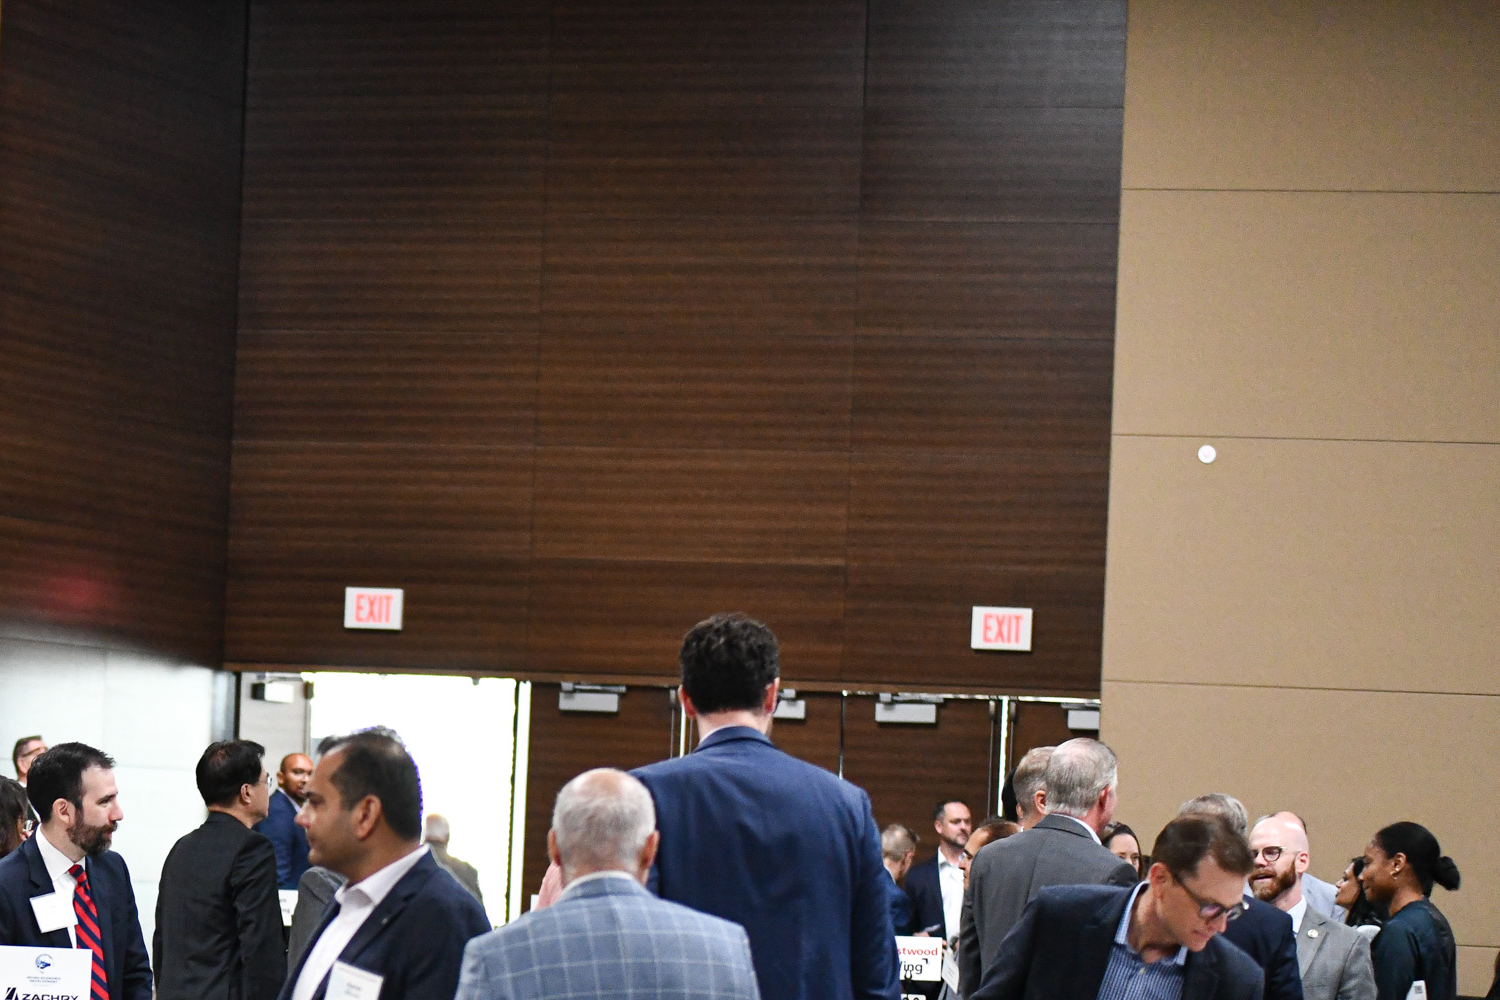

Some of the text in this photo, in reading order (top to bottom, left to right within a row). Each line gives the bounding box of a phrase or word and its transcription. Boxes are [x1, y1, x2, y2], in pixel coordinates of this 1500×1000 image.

[355, 593, 394, 624] EXIT
[982, 613, 1025, 644] EXIT
[897, 947, 938, 956] stwood
[900, 961, 923, 975] ing
